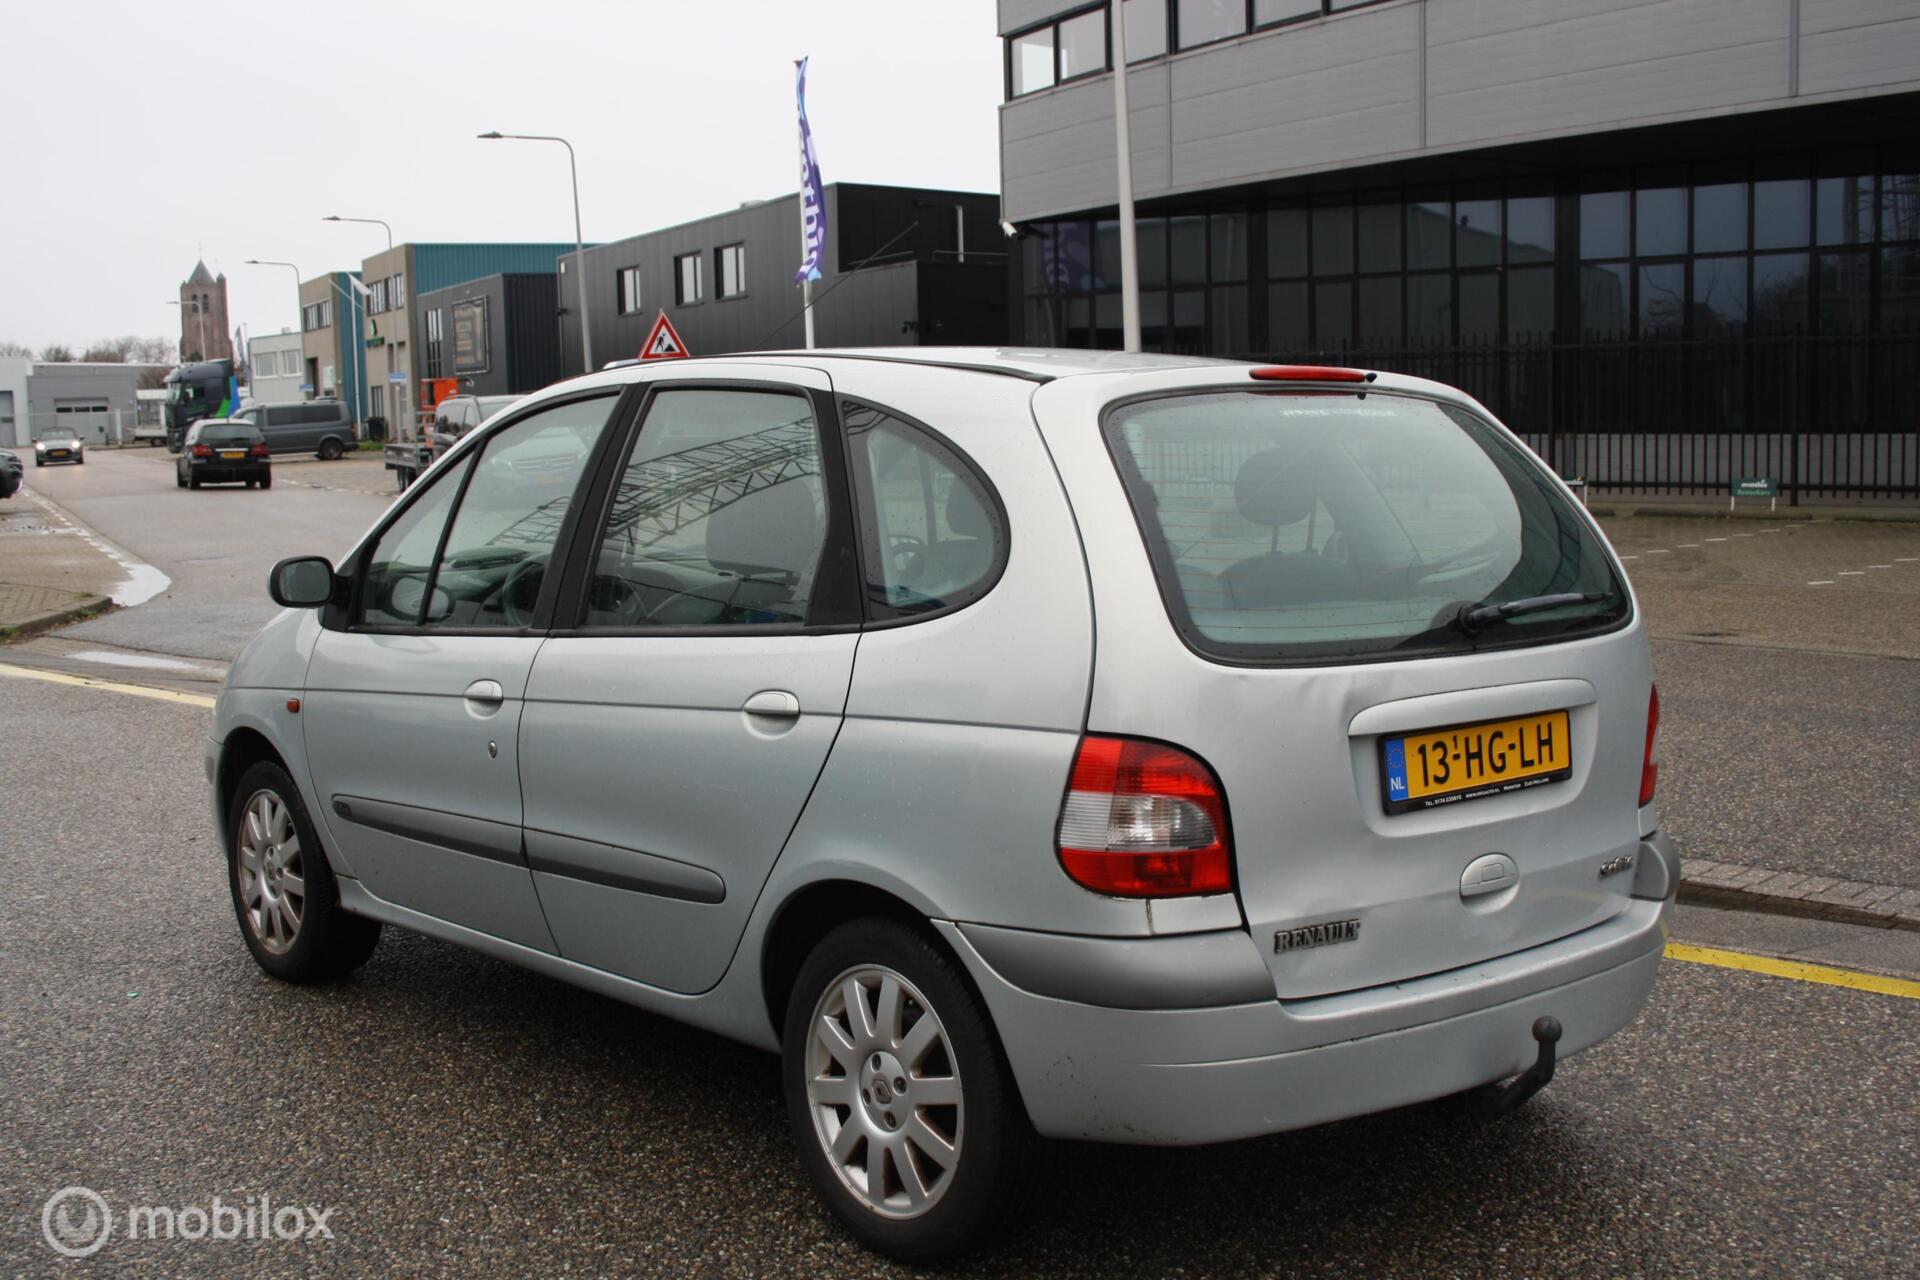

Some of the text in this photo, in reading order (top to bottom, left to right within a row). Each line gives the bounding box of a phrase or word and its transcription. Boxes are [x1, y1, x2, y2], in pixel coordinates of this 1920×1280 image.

[1418, 722, 1553, 787] 13-HG-LH
[1390, 776, 1405, 791] NL
[1274, 918, 1361, 955] RENAULT
